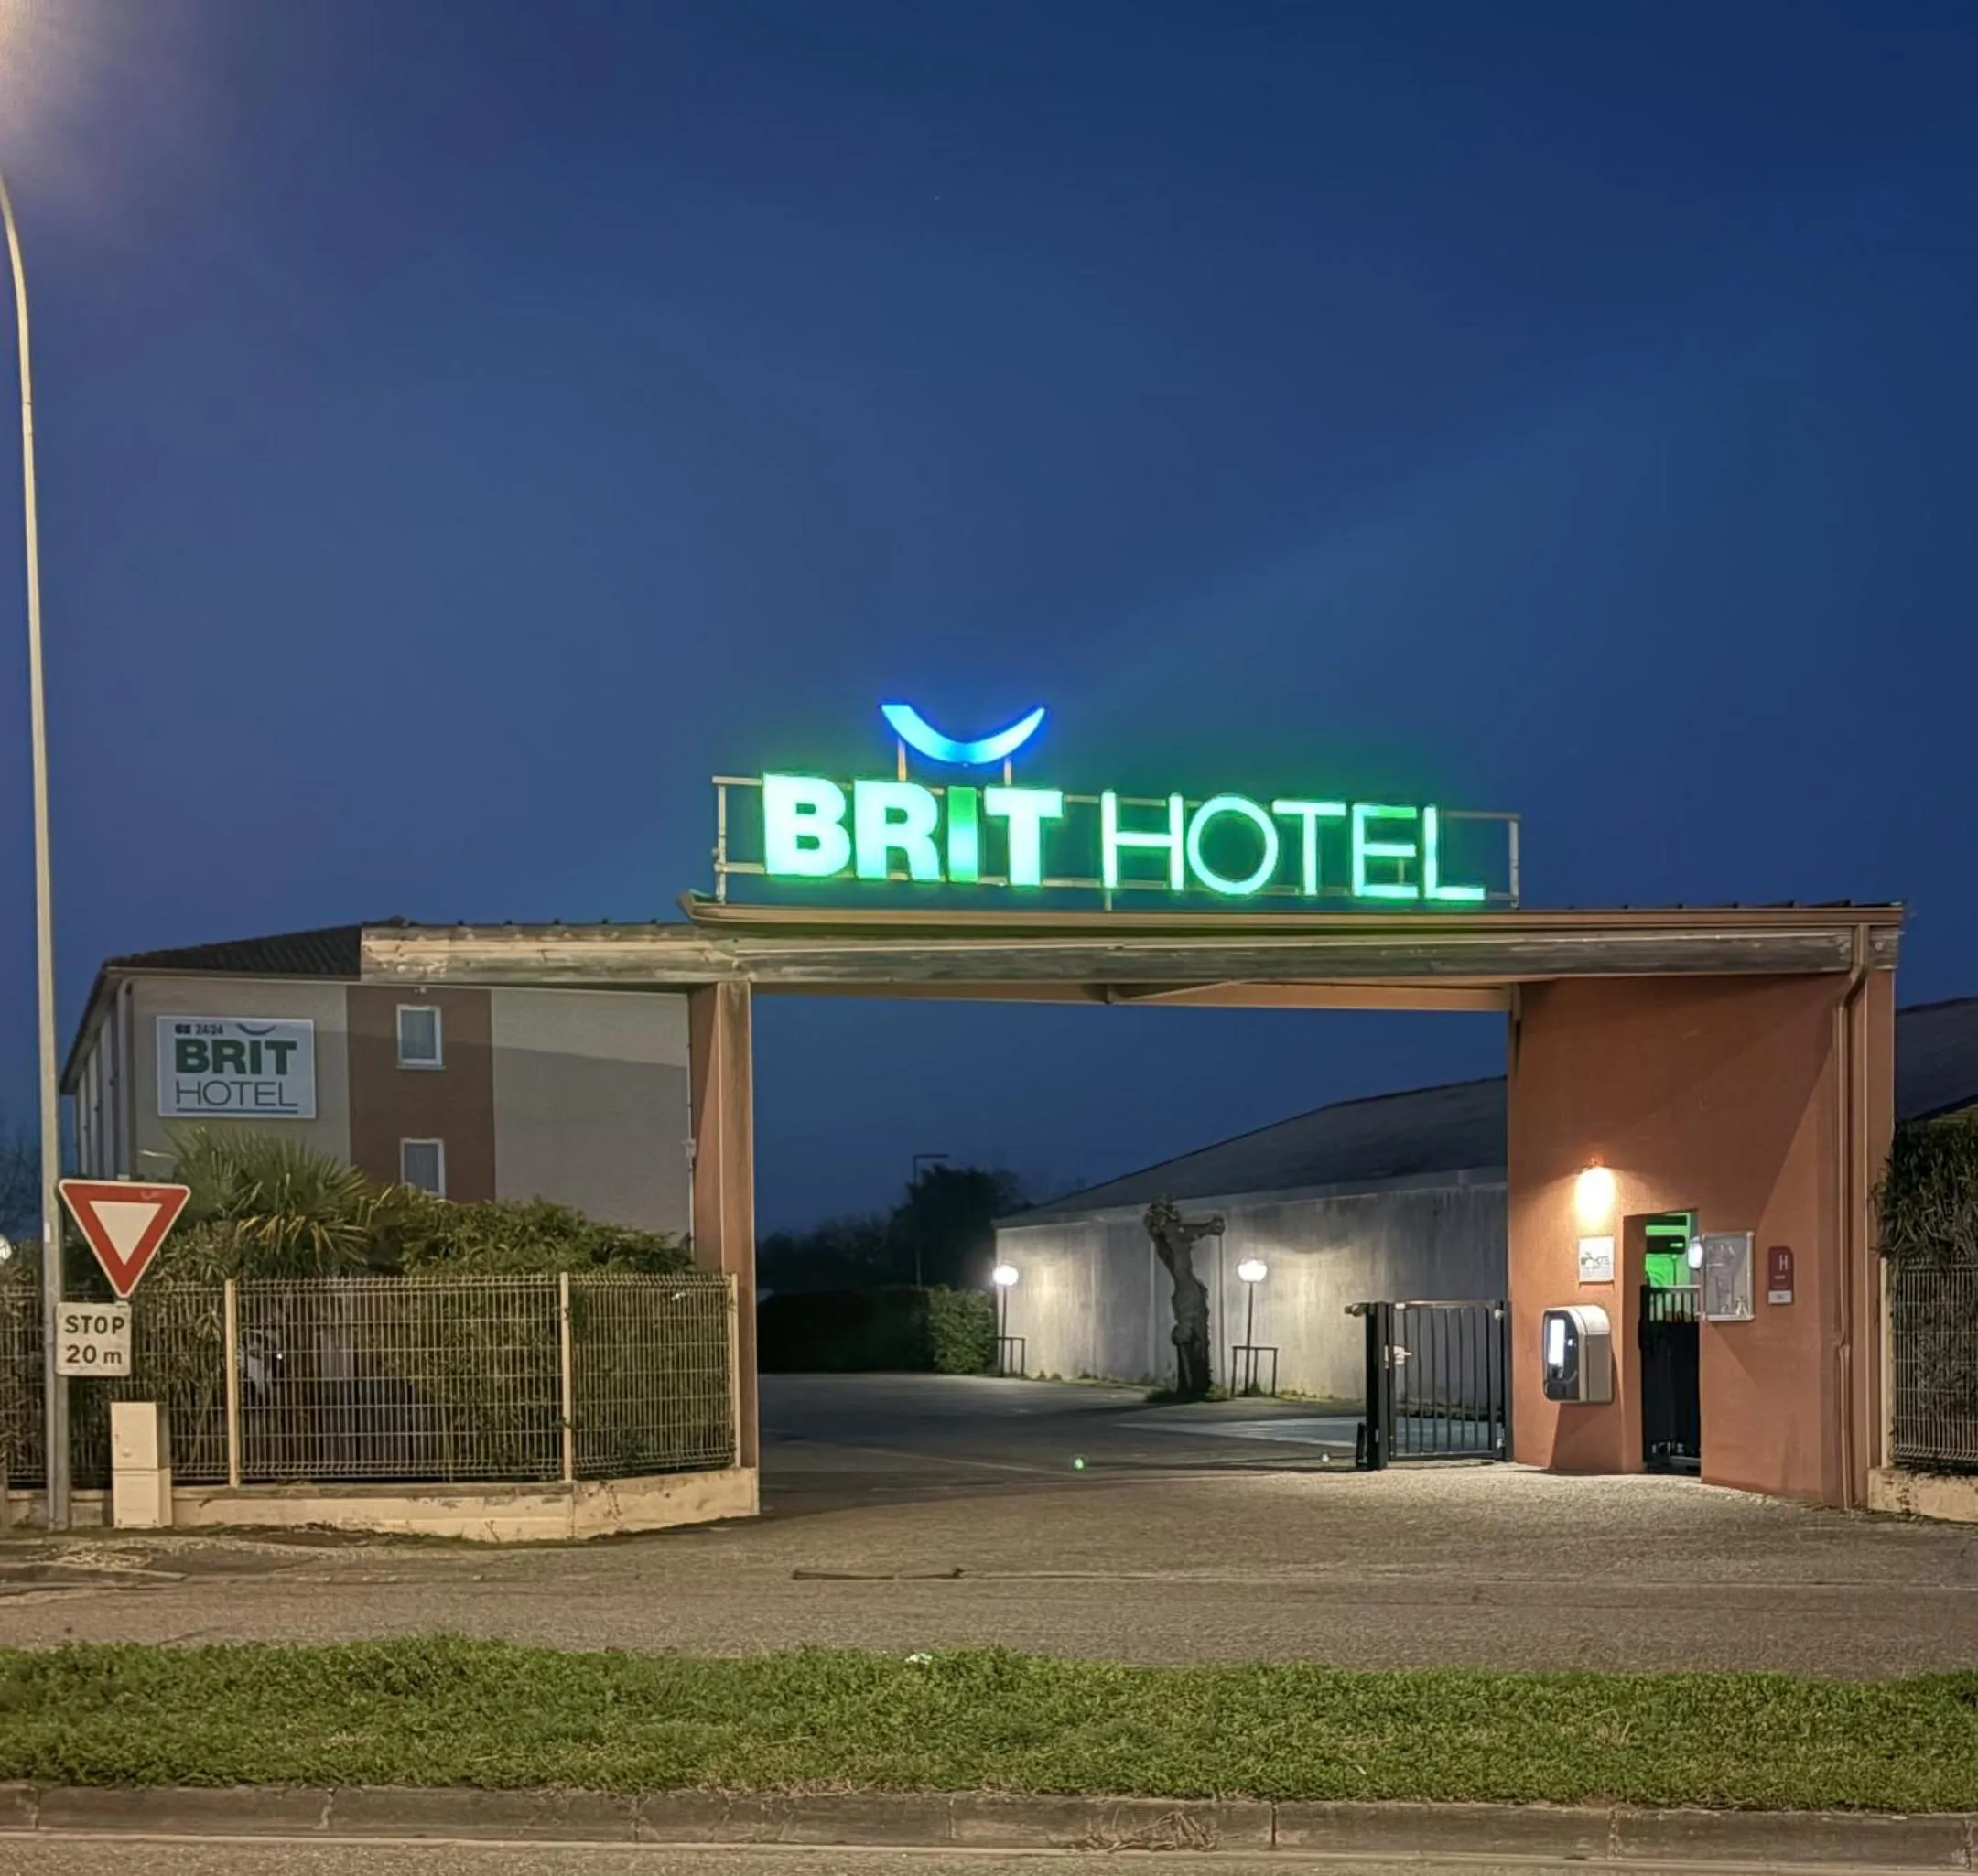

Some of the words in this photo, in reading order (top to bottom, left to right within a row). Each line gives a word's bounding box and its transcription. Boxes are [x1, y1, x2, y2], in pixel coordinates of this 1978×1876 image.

[762, 771, 1063, 886] BRIT
[1100, 791, 1485, 900] HOTEL
[175, 1038, 297, 1075] BRIT
[176, 1080, 298, 1106] HOTEL
[64, 1314, 125, 1335] STOP
[65, 1344, 97, 1364] 20
[103, 1351, 123, 1364] m
